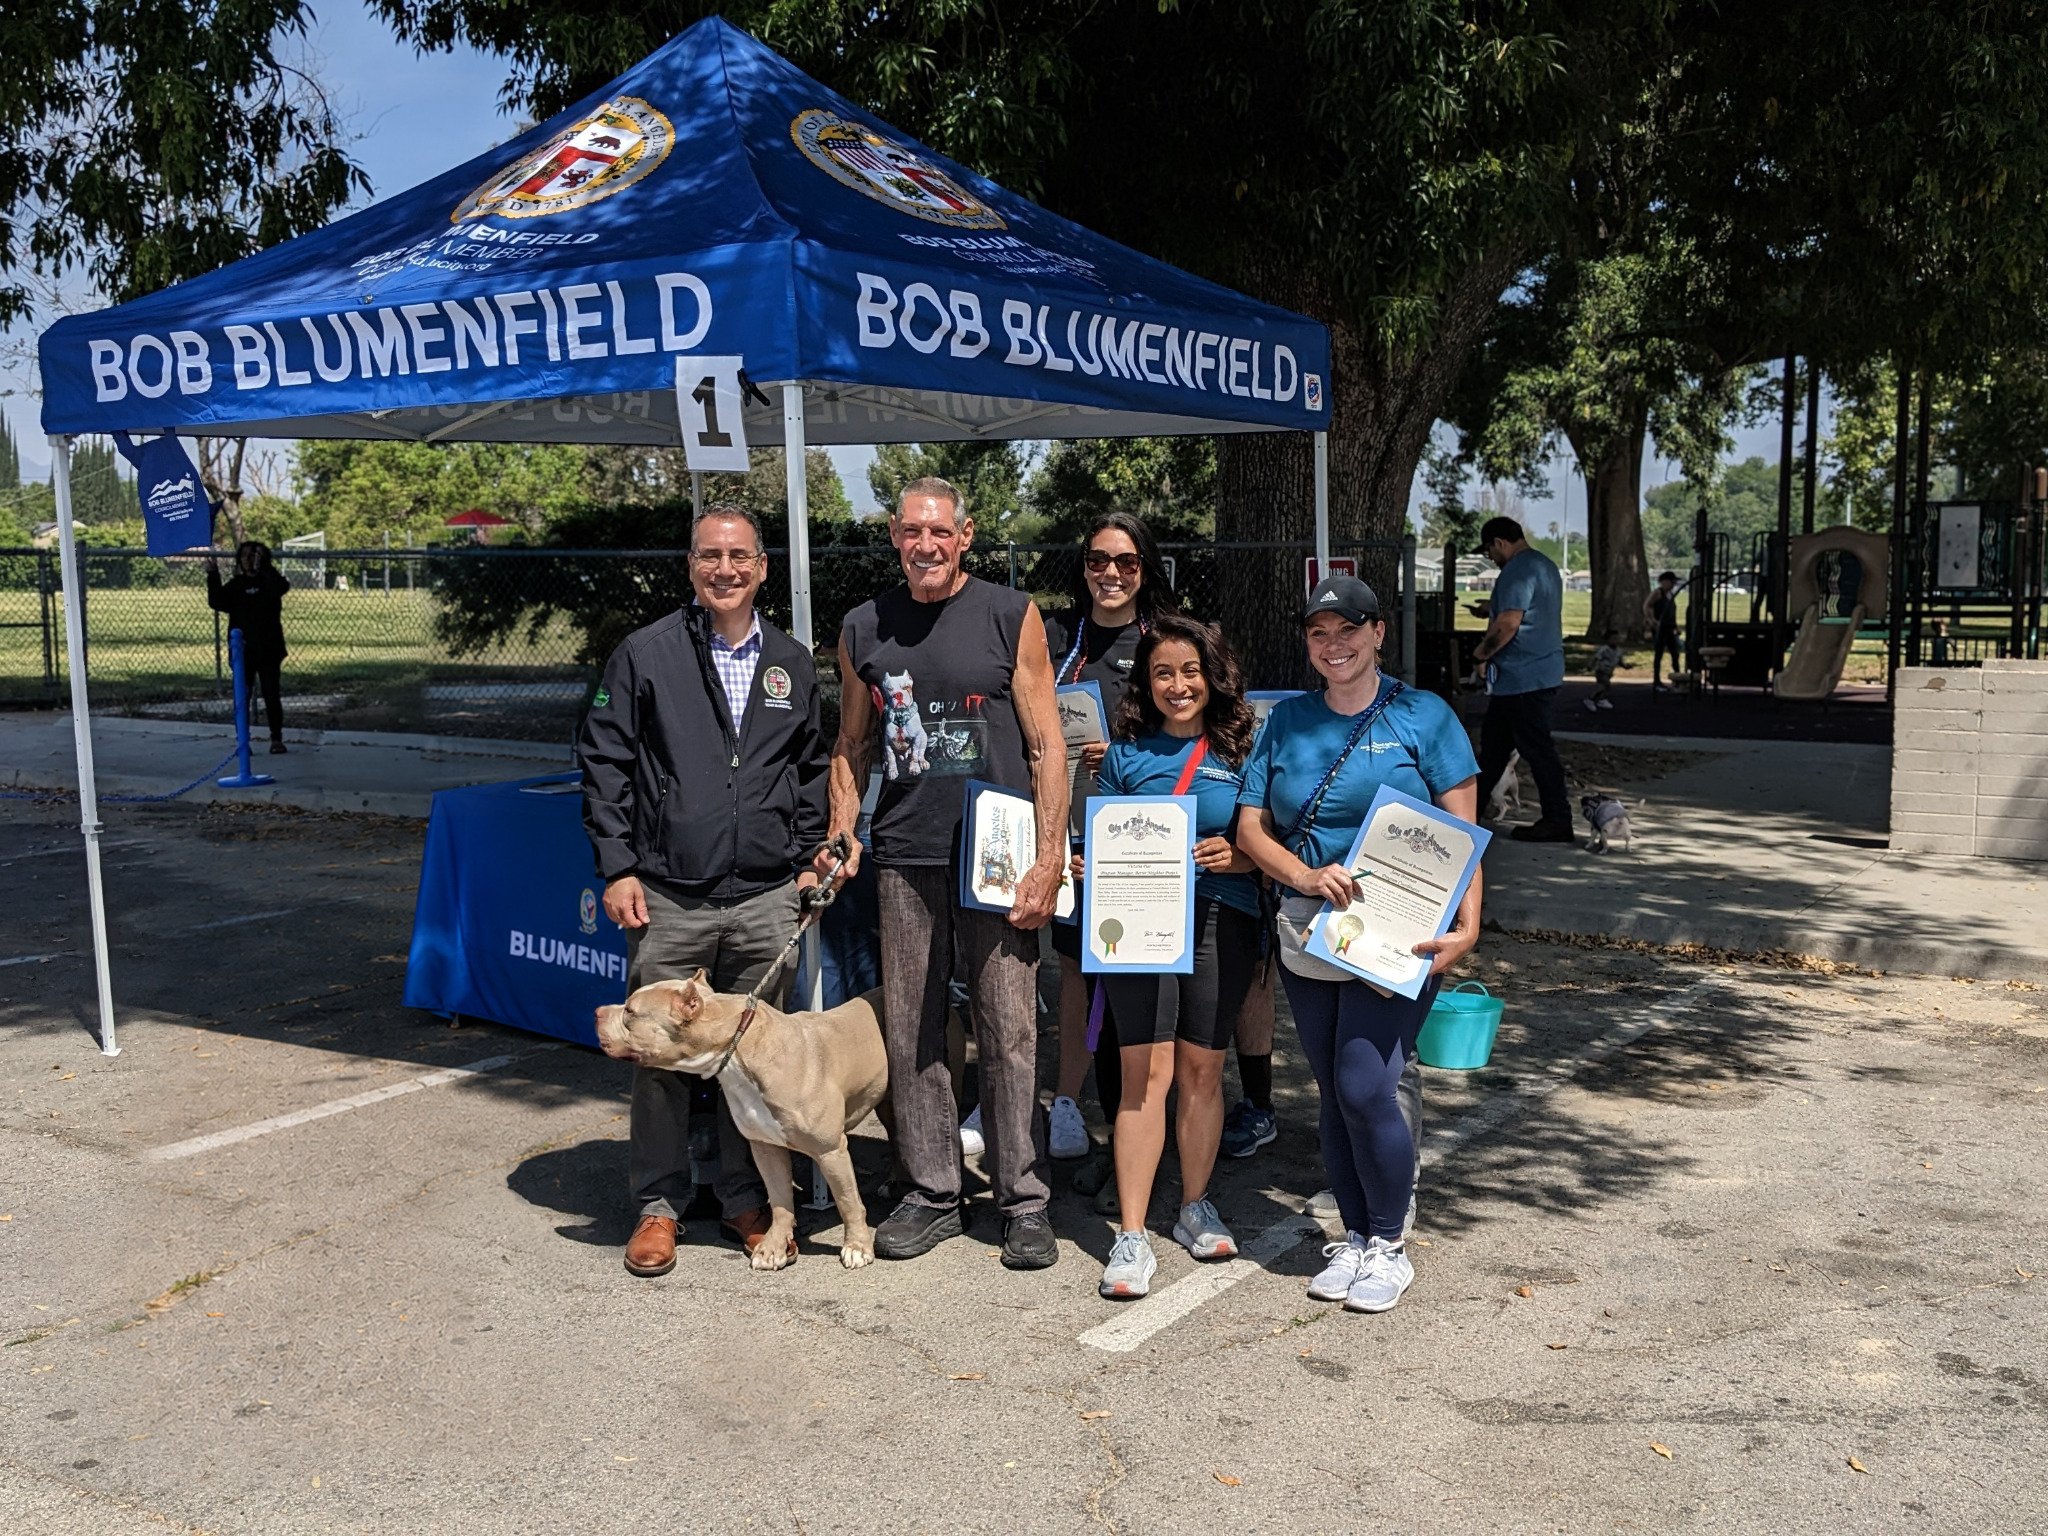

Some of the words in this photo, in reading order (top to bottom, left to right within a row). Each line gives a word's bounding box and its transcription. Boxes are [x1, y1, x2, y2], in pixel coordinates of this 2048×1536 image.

[634, 111, 666, 160] ANGELES
[535, 198, 573, 211] 1781
[436, 240, 544, 260] MEMBER
[897, 234, 957, 249] BOB
[89, 332, 212, 403] BOB
[224, 272, 714, 391] BLUMENFIELD
[856, 271, 991, 360] BOB
[1002, 299, 1298, 403] BLUMENFIELD
[692, 377, 732, 447] 1
[929, 702, 945, 713] OH
[988, 806, 1001, 847] Angeles
[1108, 823, 1121, 835] City
[1123, 820, 1130, 830] of
[1145, 816, 1171, 834] Angeles
[1387, 823, 1402, 836] City
[1403, 828, 1413, 837] of
[1413, 827, 1428, 839] Los
[1427, 833, 1452, 860] Angeles
[509, 930, 627, 982] BLUMENFI
